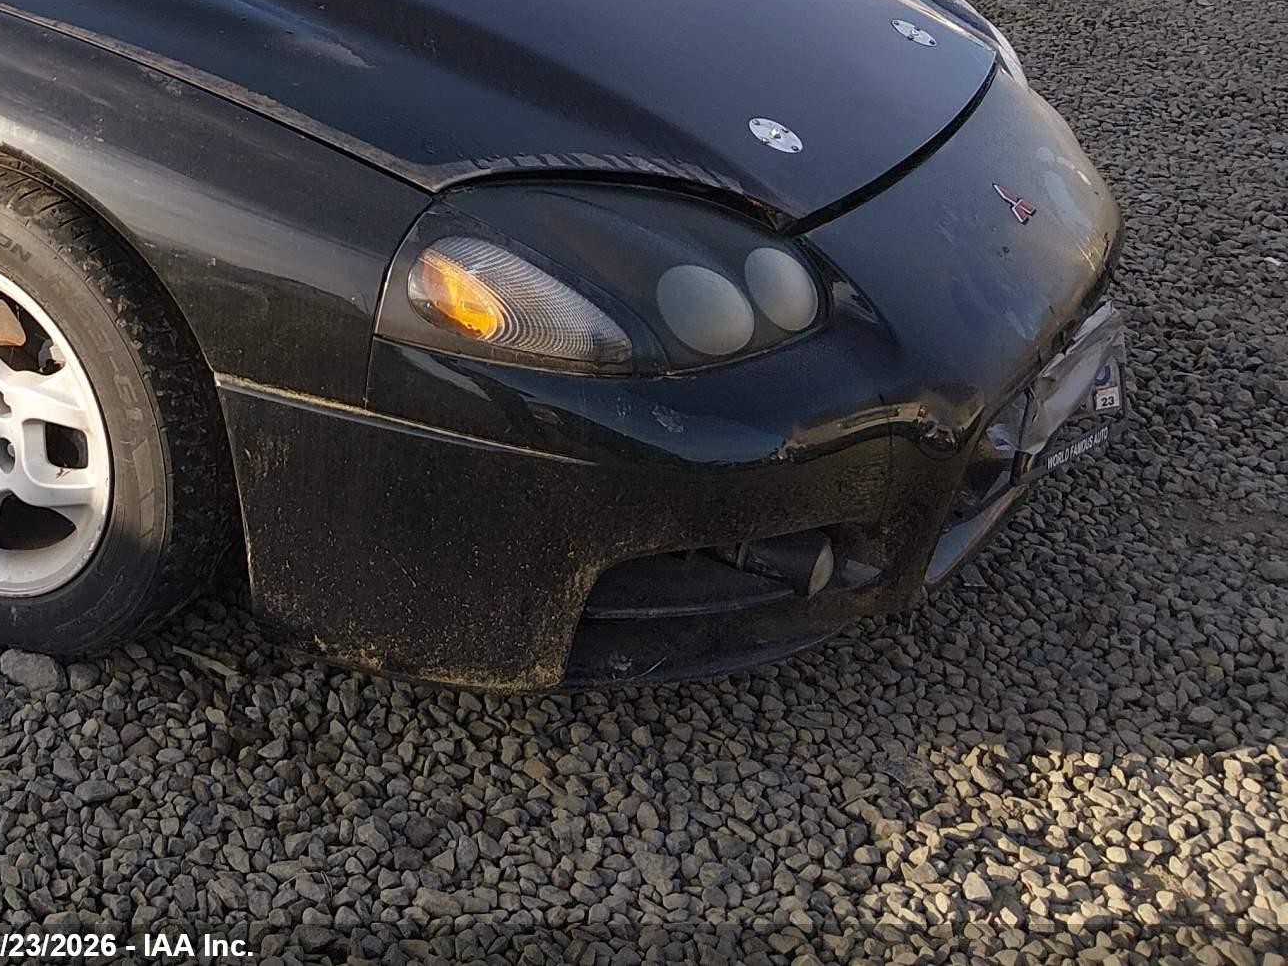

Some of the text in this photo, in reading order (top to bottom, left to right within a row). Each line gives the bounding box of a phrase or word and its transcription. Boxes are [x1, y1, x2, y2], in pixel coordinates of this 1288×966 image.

[1101, 396, 1115, 407] 23
[1047, 426, 1109, 470] WORLD FAMOUS AUTO
